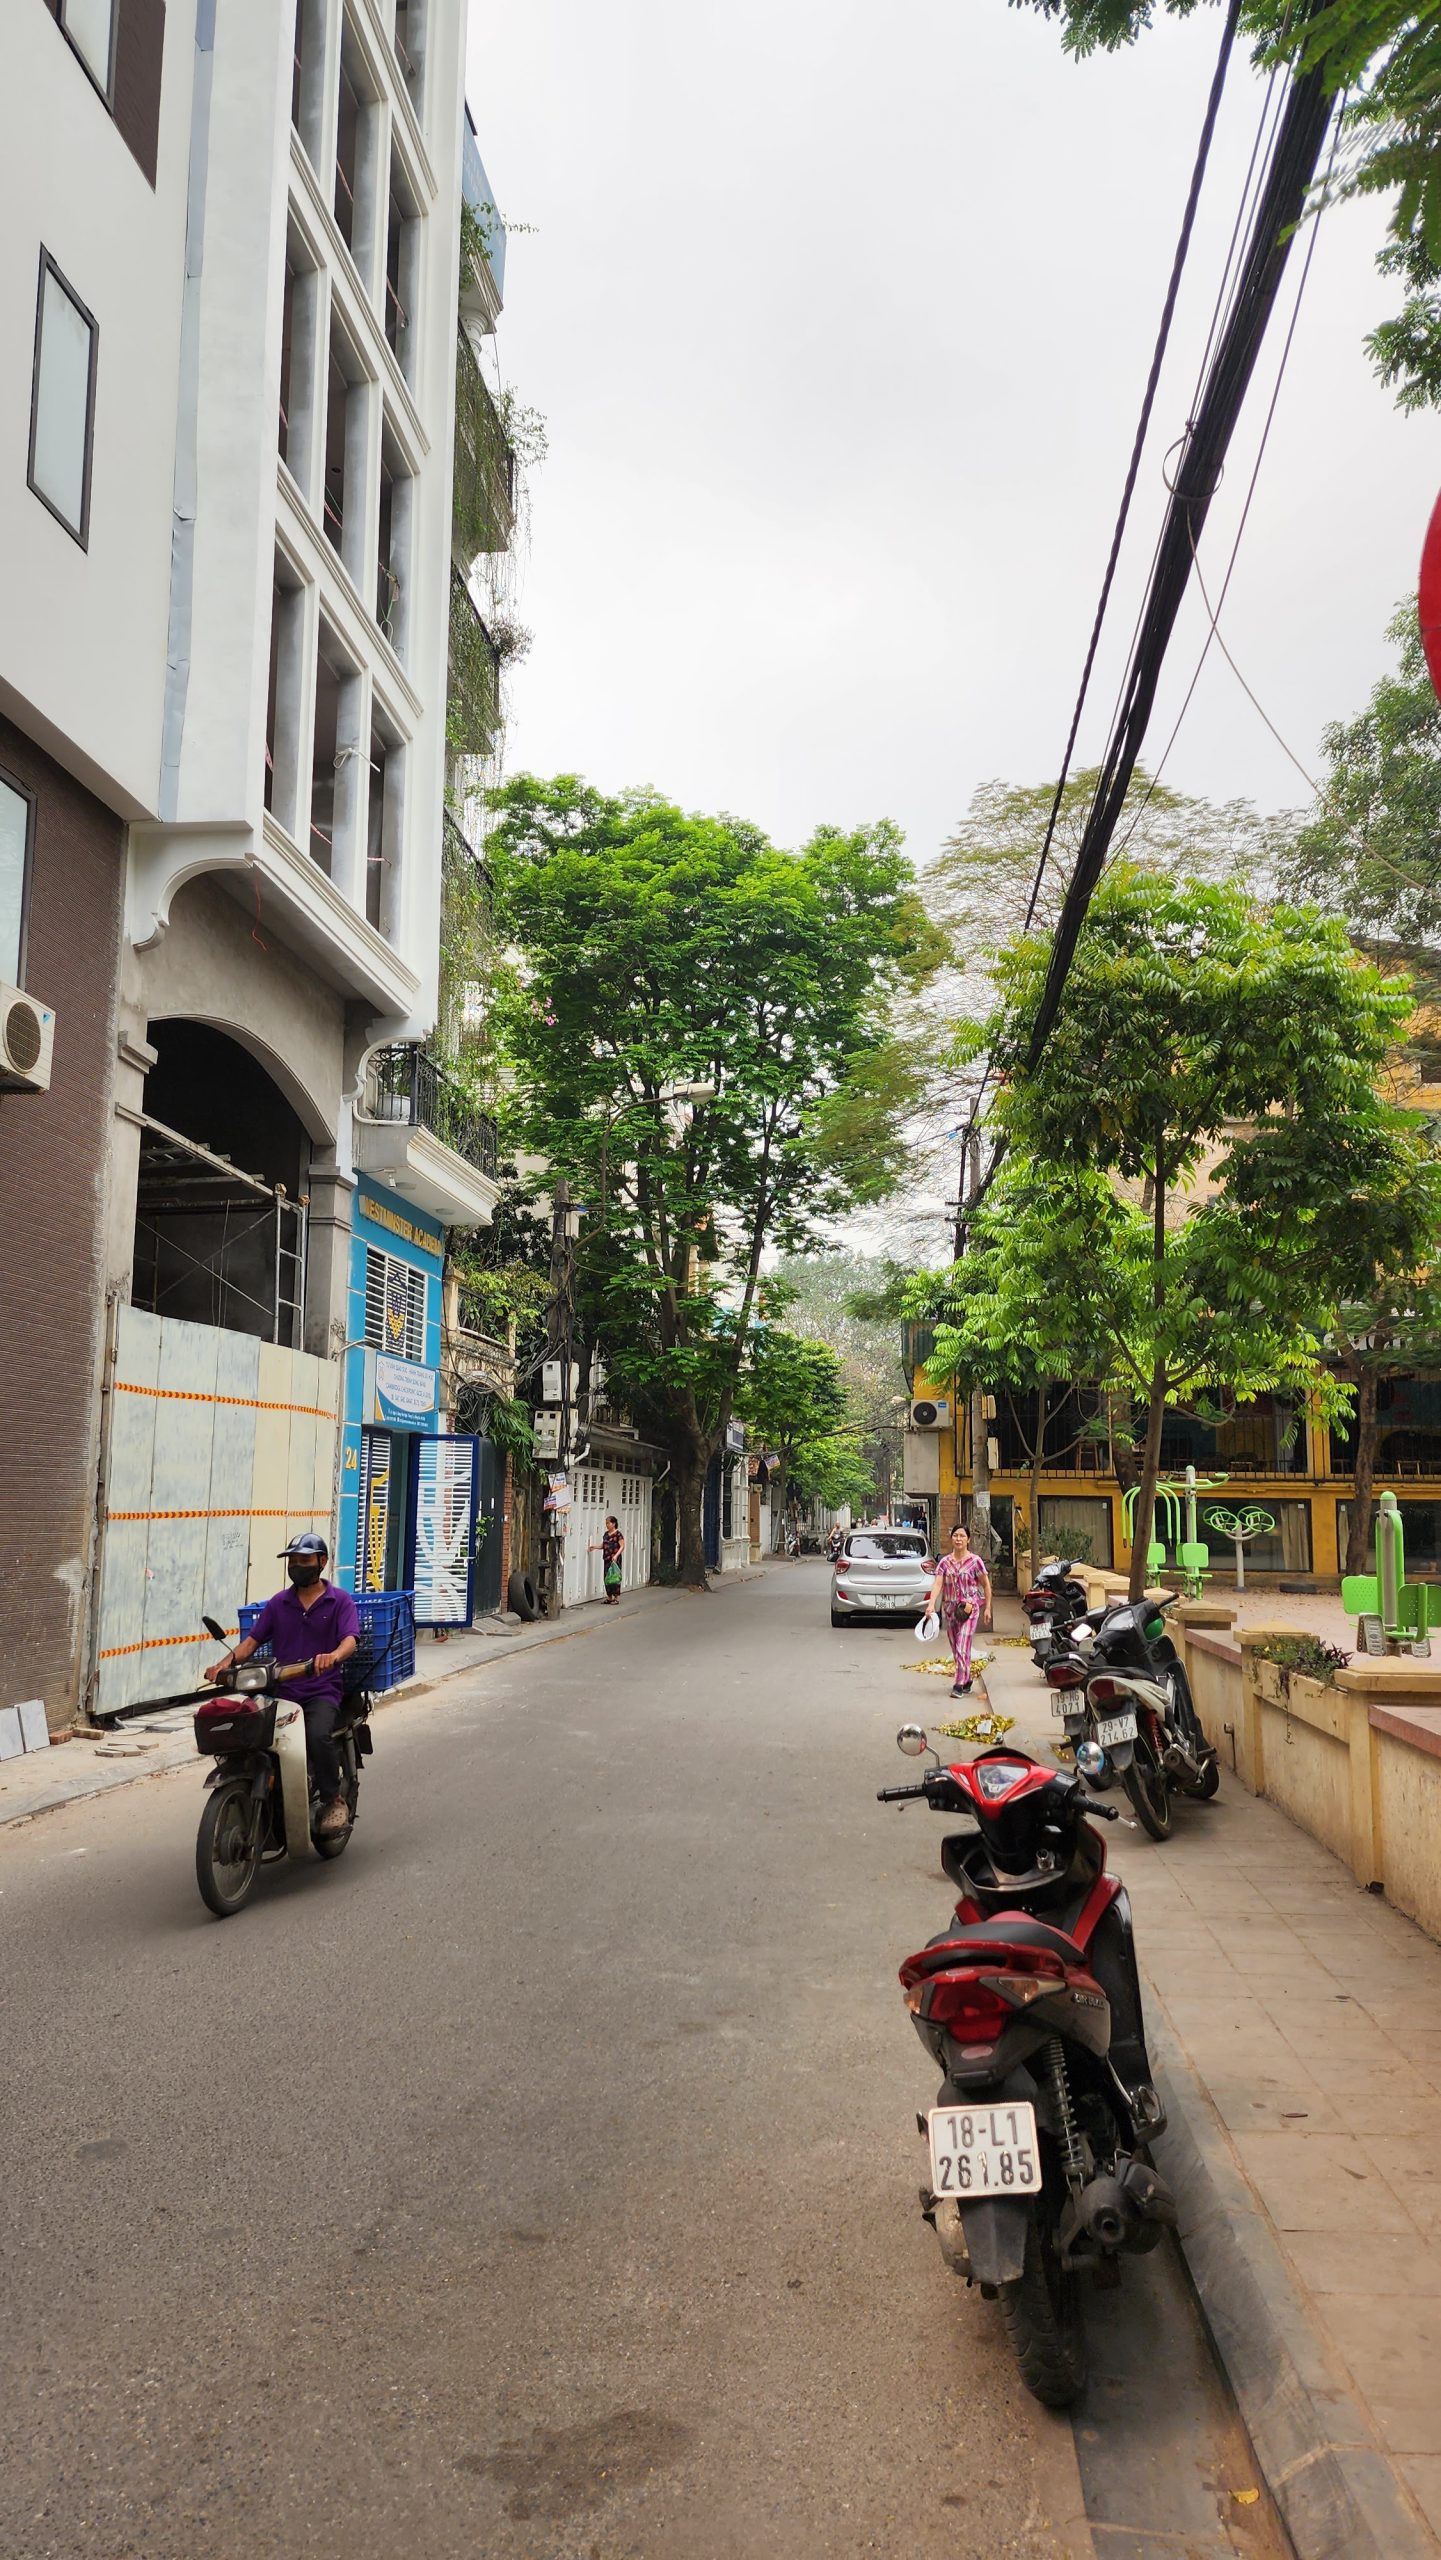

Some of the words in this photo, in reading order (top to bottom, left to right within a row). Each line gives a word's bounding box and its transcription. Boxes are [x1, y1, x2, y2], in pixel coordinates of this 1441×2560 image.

[364, 1196, 413, 1241] WESTMINSTER
[345, 1446, 357, 1470] 24
[1100, 1727, 1135, 1746] 214.62
[1102, 1716, 1129, 1733] 29-V7
[947, 2111, 1018, 2149] 18-L1
[939, 2149, 1034, 2191] 261.85
